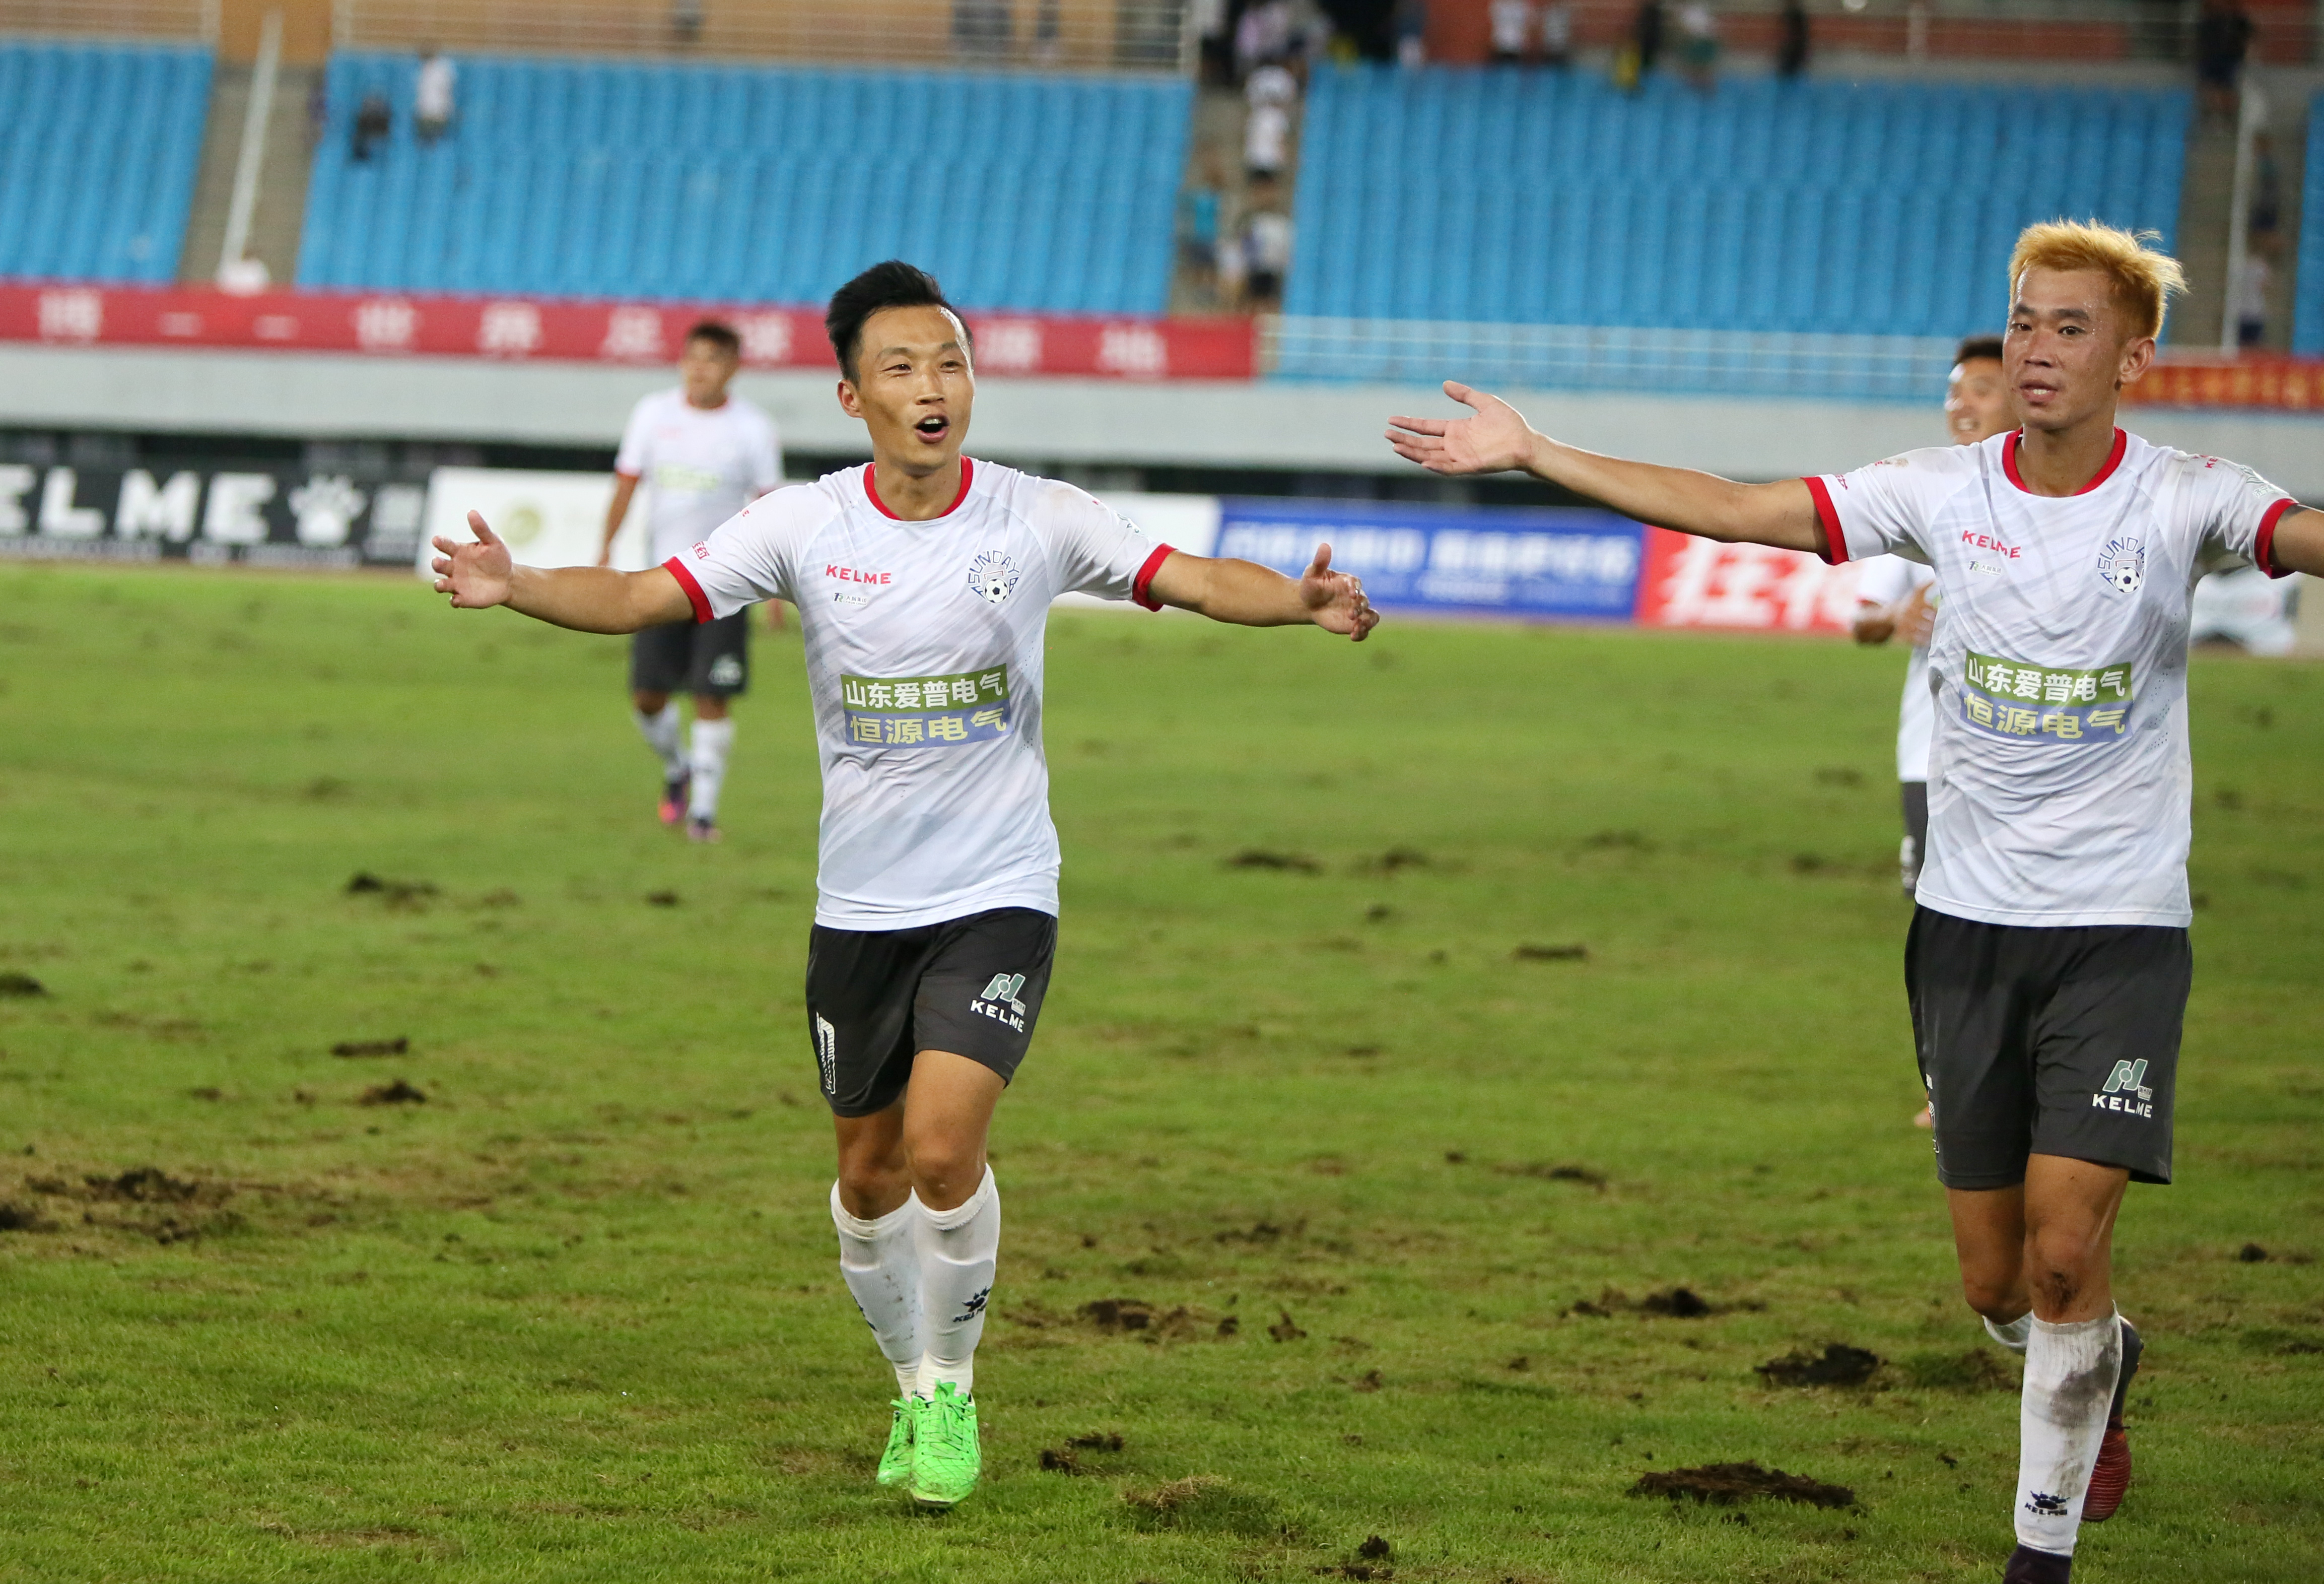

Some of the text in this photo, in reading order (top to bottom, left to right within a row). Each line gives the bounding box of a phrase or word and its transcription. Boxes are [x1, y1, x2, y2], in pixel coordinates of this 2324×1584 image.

[1962, 530, 2021, 558] KELME
[826, 564, 892, 584] KELME
[845, 672, 1002, 709] 山东爱普电气
[1968, 657, 2126, 702] 山东爱普电气
[850, 707, 1007, 745] 恒源电气
[1963, 692, 2126, 739] 恒源电气
[970, 1000, 1024, 1033] KELME
[2092, 1093, 2153, 1118] KELME
